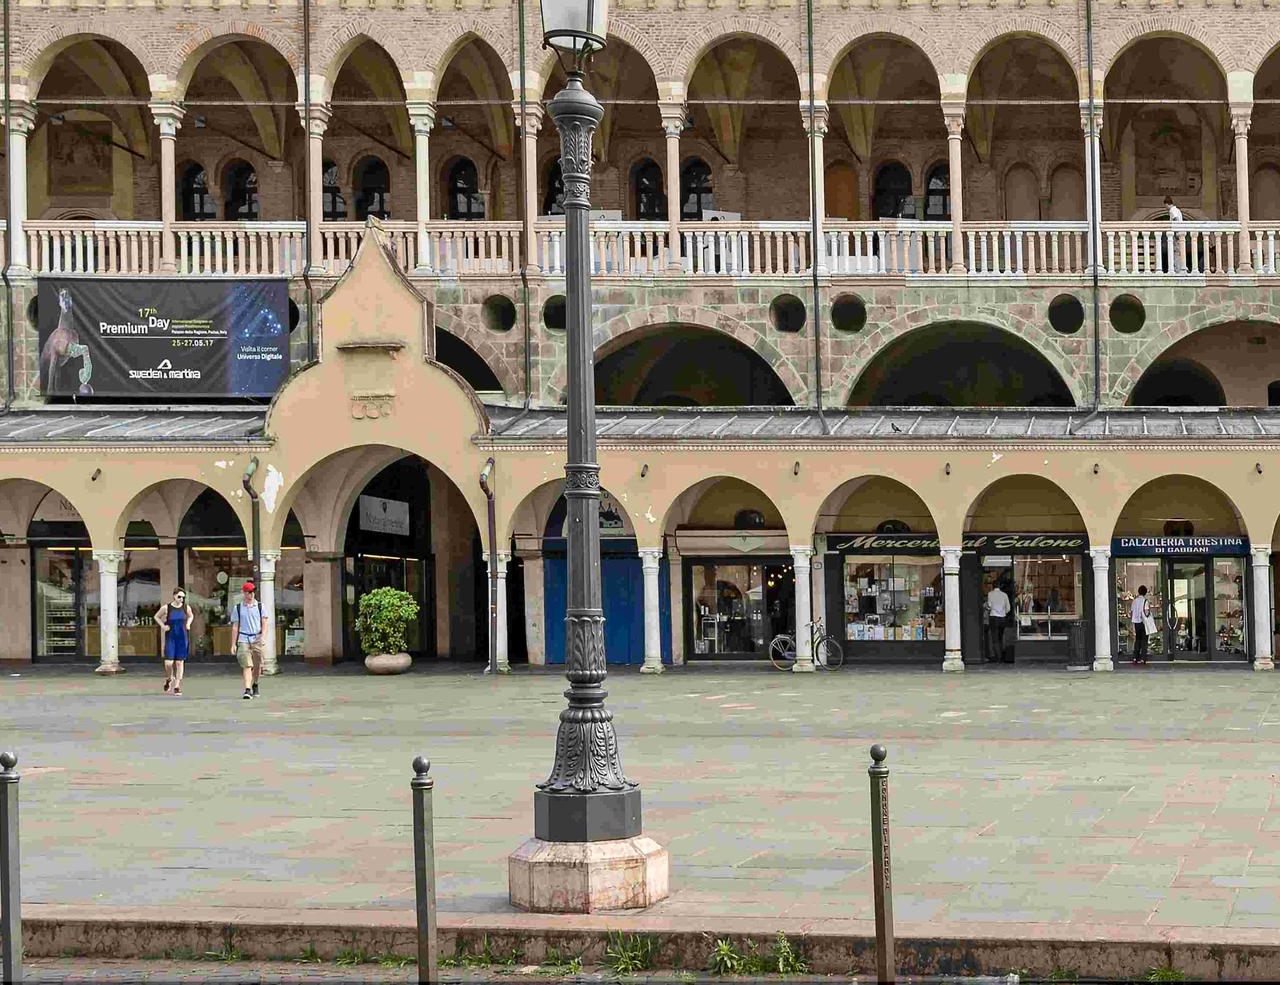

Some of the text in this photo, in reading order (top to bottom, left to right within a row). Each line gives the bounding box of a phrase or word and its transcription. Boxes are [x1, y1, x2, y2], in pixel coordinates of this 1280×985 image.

[138, 307, 158, 318] 17th
[100, 316, 170, 334] Premium Day
[172, 339, 214, 347] 25-27.05.17
[128, 368, 162, 379] sweden
[168, 368, 201, 379] martina
[836, 536, 940, 549] Merceri
[993, 535, 1084, 548] Salone
[1121, 537, 1243, 547] CALZOLERIA TRIESTINA
